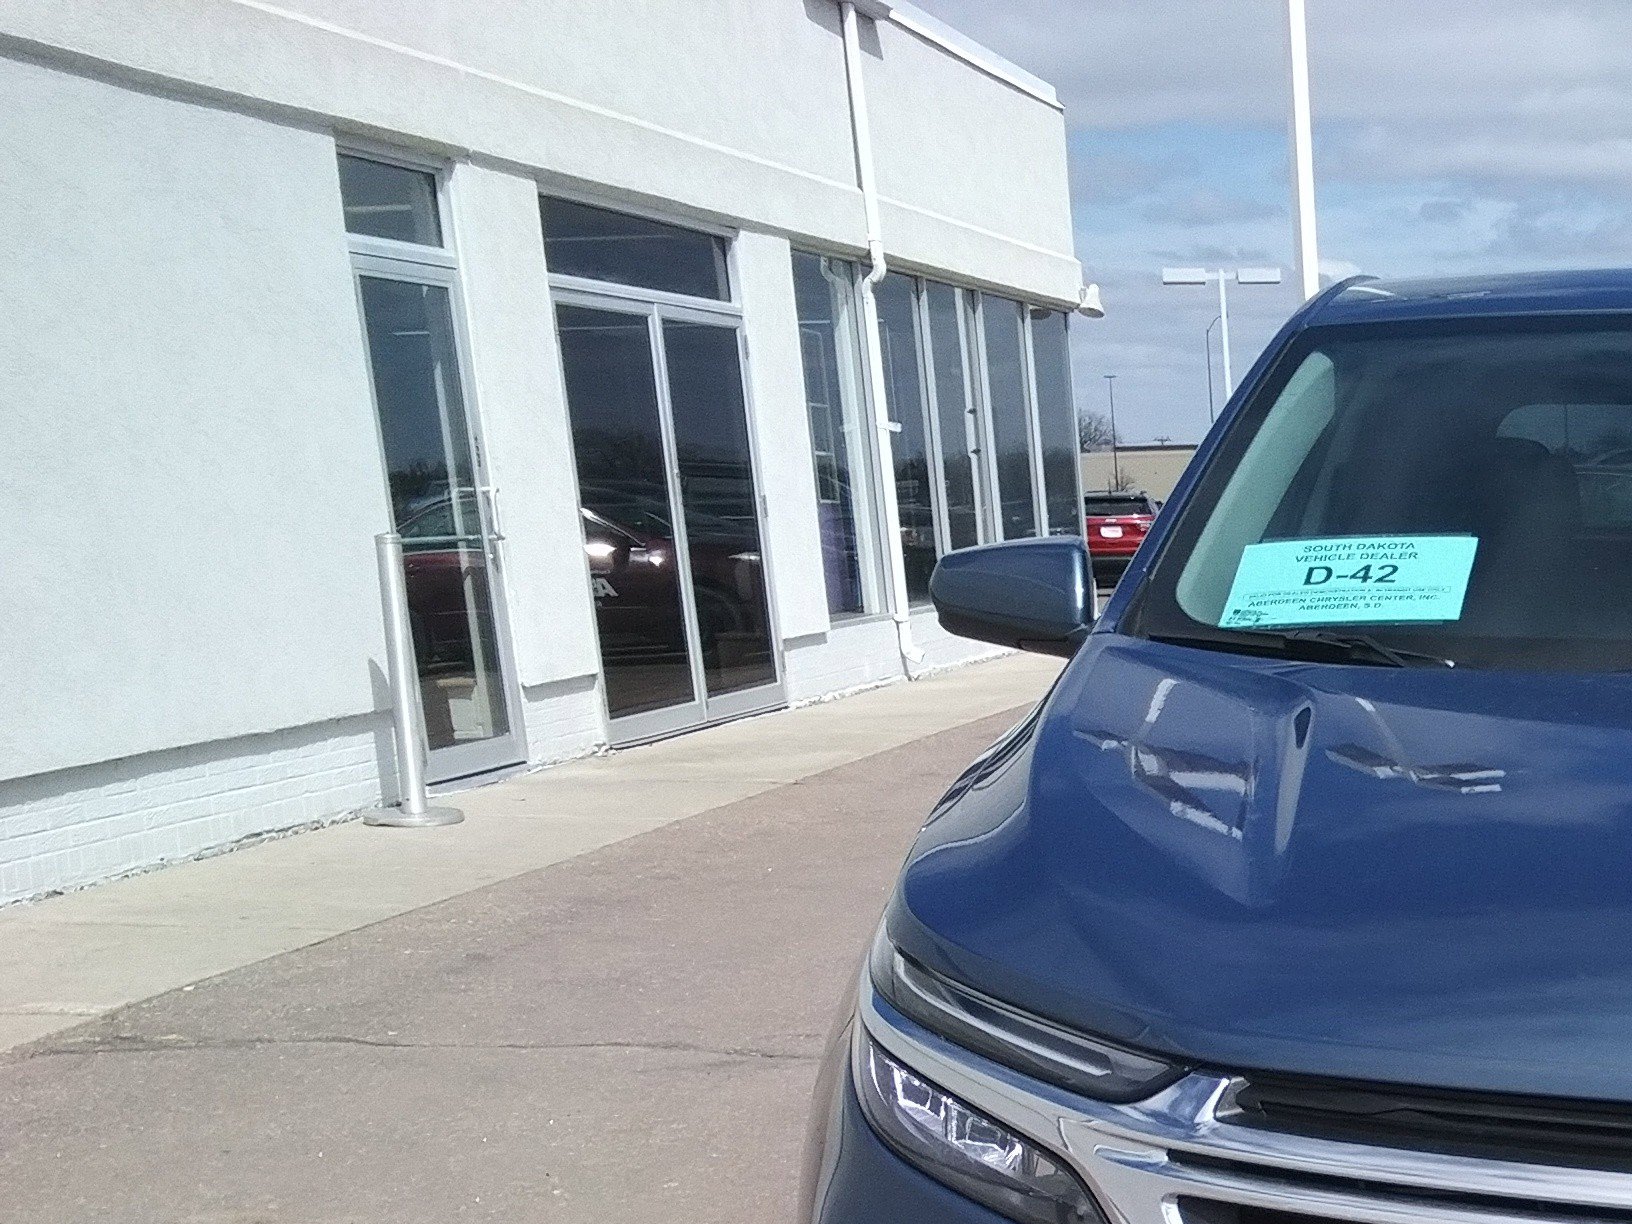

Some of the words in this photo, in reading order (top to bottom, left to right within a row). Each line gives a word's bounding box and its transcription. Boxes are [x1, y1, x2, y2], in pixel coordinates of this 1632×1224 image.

[1303, 543, 1353, 553] SOUTH
[1356, 542, 1416, 551] DAKOTA
[1295, 552, 1356, 563] VEHICLE
[1359, 551, 1419, 560] DEALER
[1302, 564, 1400, 586] D-42
[1247, 598, 1307, 608] ABERDEEN
[1309, 595, 1367, 603] CHRYSLER
